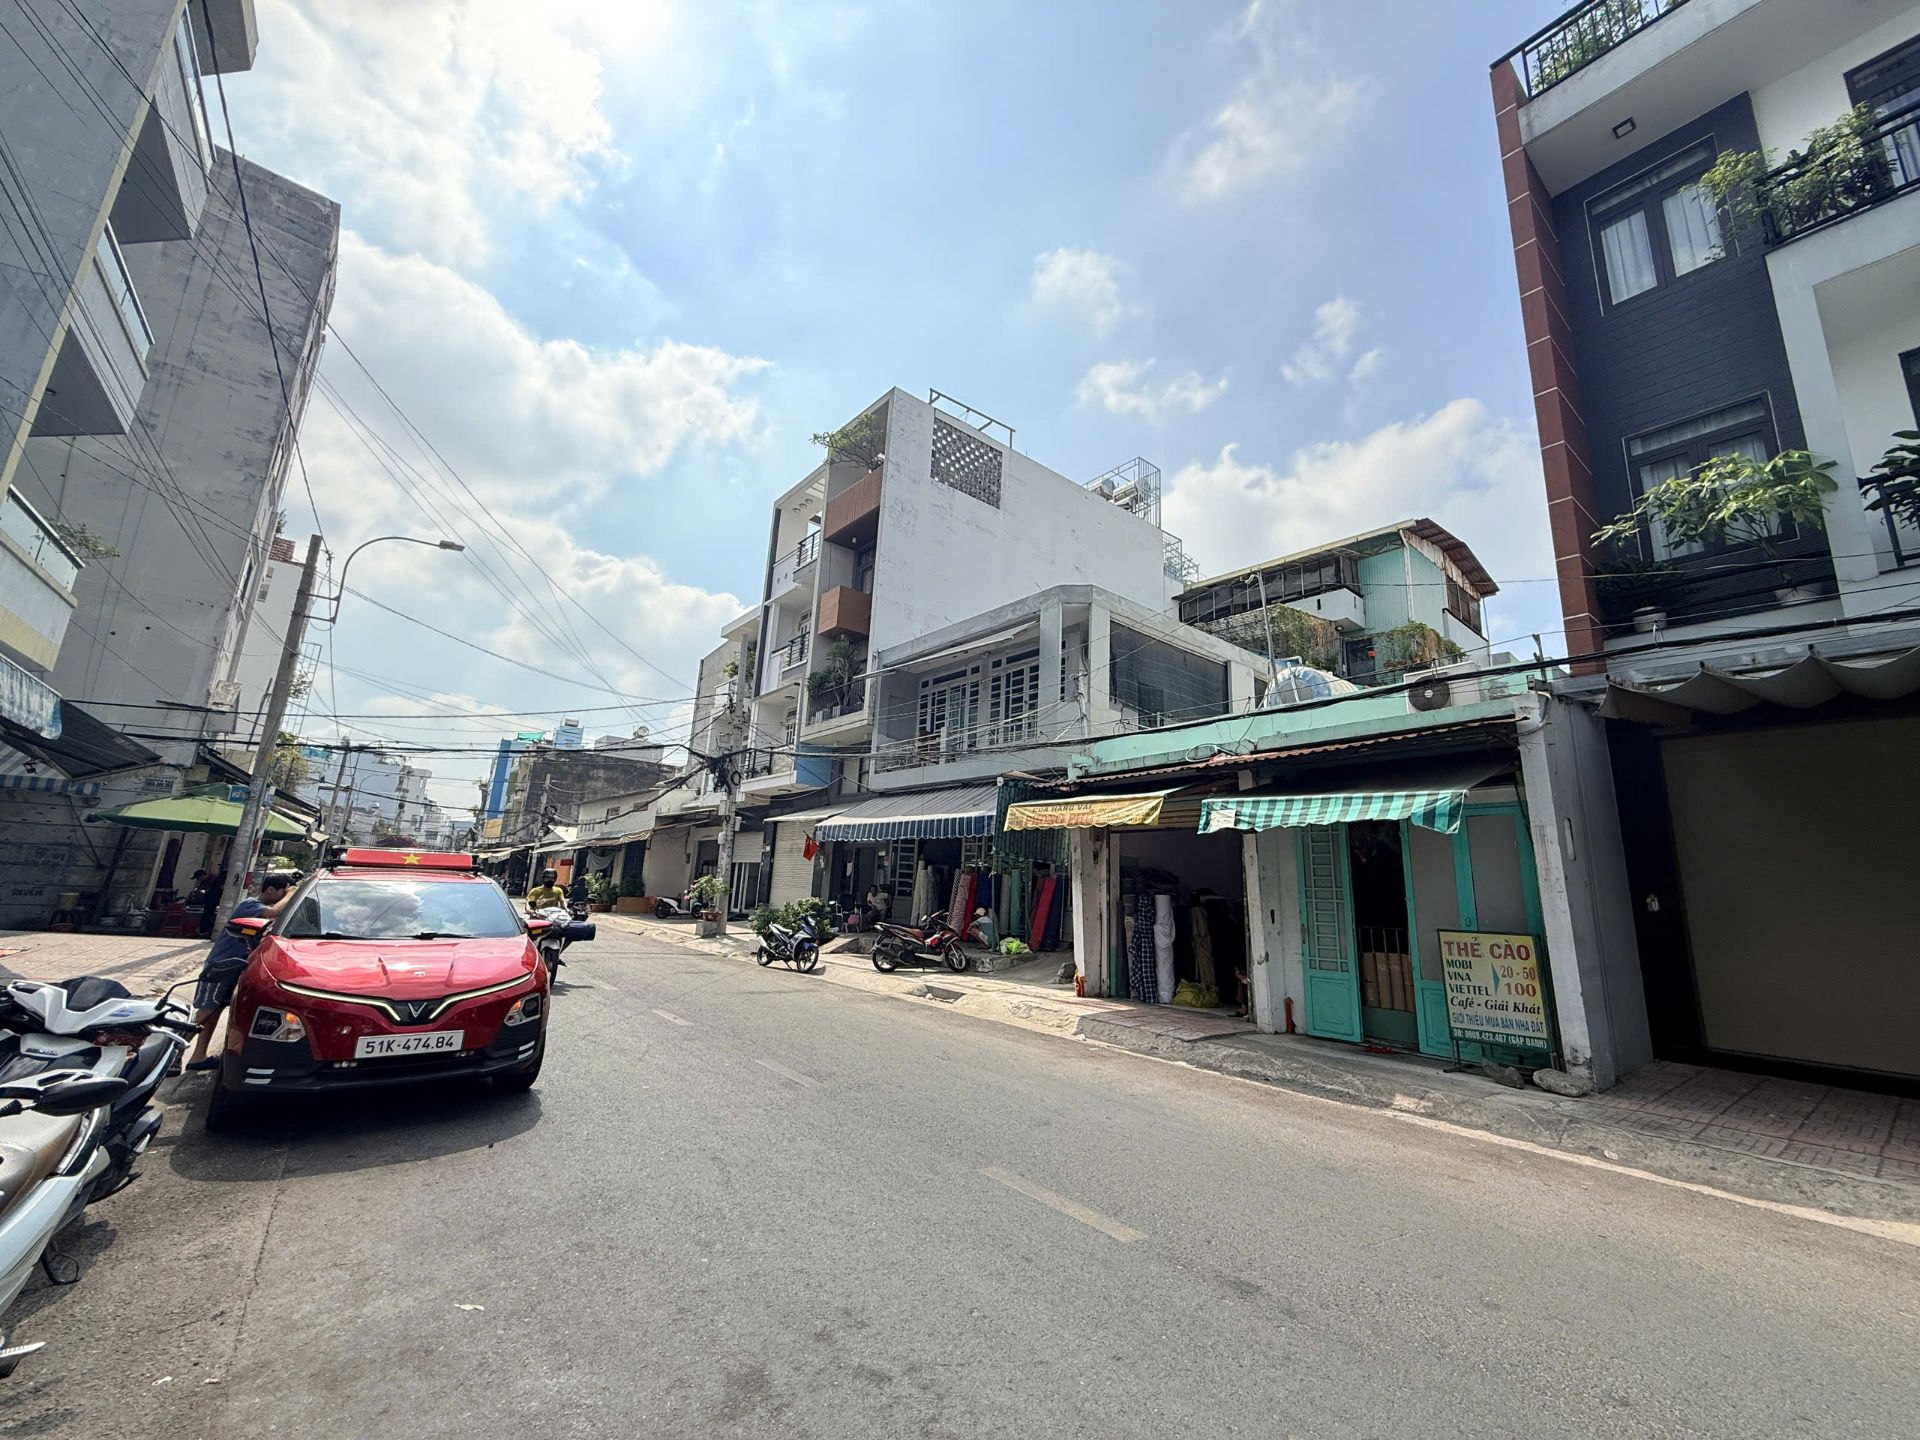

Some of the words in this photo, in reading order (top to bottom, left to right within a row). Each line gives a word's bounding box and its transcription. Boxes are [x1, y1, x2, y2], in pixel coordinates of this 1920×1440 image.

[1444, 937, 1482, 958] THẺ
[1489, 939, 1531, 961] CÀO
[1446, 959, 1472, 970] MOBI
[1447, 971, 1472, 982] VINA
[1500, 965, 1513, 979] 20
[1522, 966, 1536, 980] 50
[1448, 983, 1492, 996] VIETTEL
[1504, 982, 1536, 997] 100
[1450, 996, 1474, 1010] Café
[1512, 1001, 1541, 1015] Khát
[1484, 1015, 1500, 1028] MUA
[365, 1035, 454, 1054] 51K-474.84
